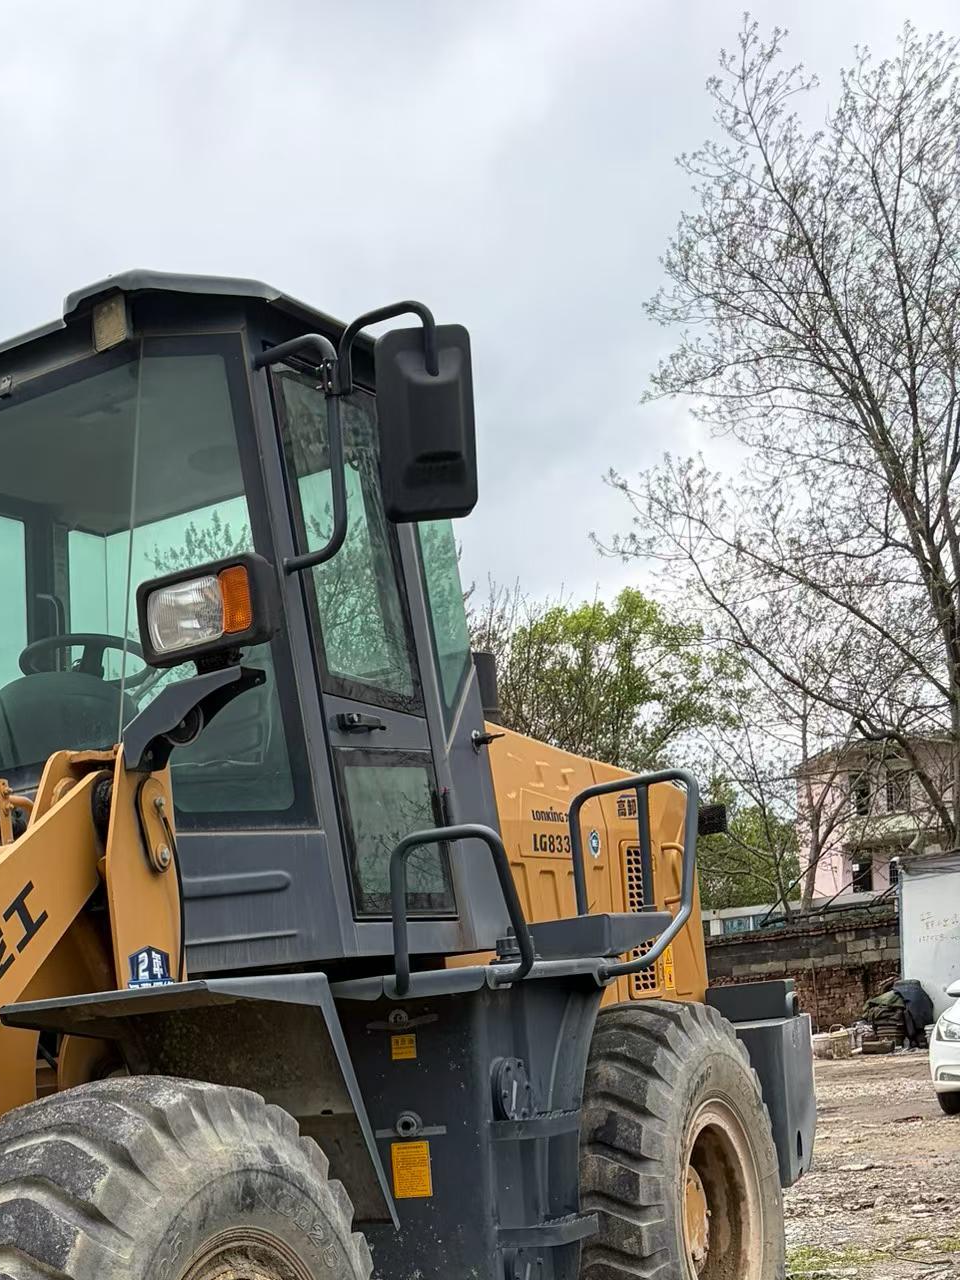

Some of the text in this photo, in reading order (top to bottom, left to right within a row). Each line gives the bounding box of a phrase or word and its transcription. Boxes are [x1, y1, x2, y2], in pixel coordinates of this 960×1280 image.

[531, 806, 565, 823] LONKING
[533, 833, 571, 853] LG833
[138, 951, 164, 980] 2年
